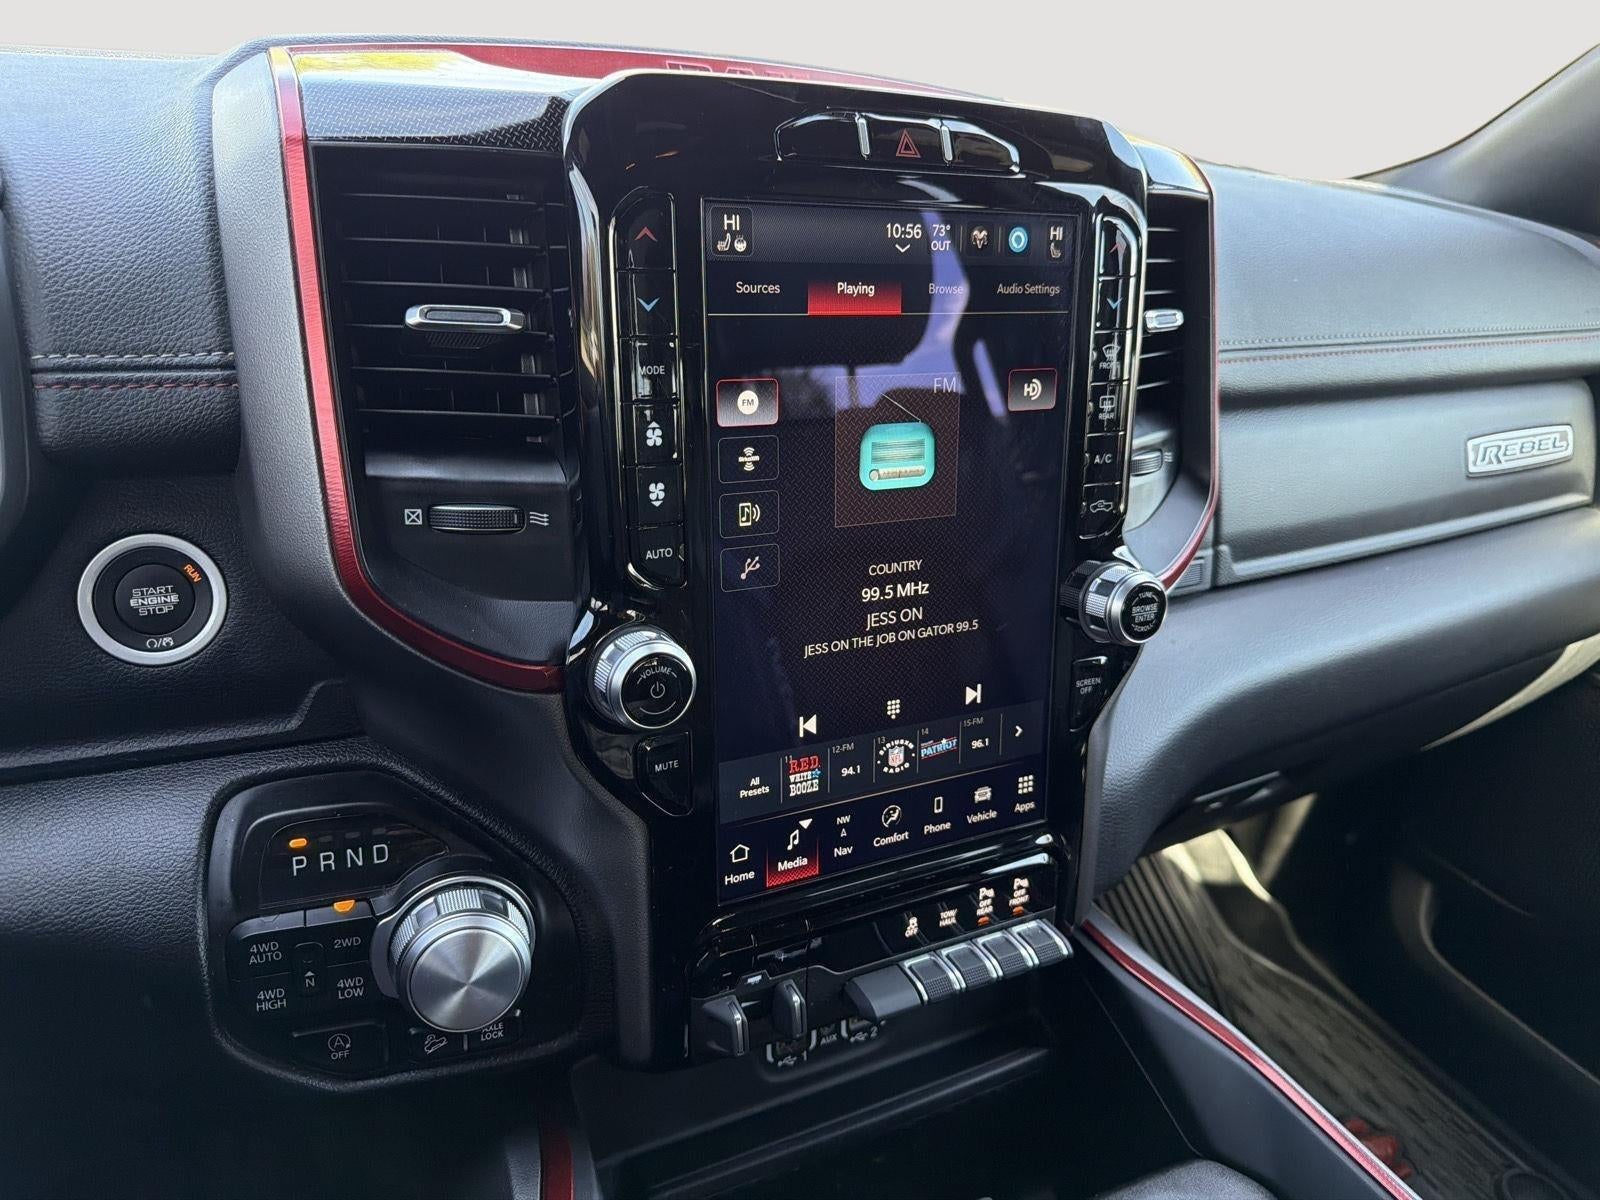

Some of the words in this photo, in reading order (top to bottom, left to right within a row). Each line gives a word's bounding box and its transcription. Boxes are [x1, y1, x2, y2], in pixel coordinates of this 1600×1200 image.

[723, 214, 740, 231] HI
[886, 223, 922, 239] 10:56
[932, 224, 951, 237] 73°
[1049, 226, 1064, 241] HI
[930, 240, 951, 251] OUT
[735, 281, 780, 295] Sources
[837, 281, 875, 297] Playing
[928, 283, 964, 295] Browse
[997, 283, 1024, 295] Audio
[1024, 283, 1061, 297] Settings
[638, 365, 666, 375] MODE
[933, 377, 957, 394] FM
[741, 398, 755, 407] FM
[1098, 412, 1115, 420] REAR
[1475, 432, 1568, 465] REBEL
[1094, 453, 1113, 464] A/C
[645, 547, 673, 560] AUTO
[183, 564, 202, 583] RUN
[868, 559, 923, 576] COUNTRY
[132, 585, 174, 597] START
[861, 585, 894, 603] 99.5
[896, 581, 930, 599] MHz
[1138, 591, 1153, 599] TUNE
[129, 594, 180, 607] ENGINE
[138, 605, 174, 616] STOP
[1131, 603, 1158, 614] BROWSE
[866, 610, 897, 631] JESS
[899, 607, 923, 624] ON
[1134, 613, 1155, 623] ENTER
[804, 643, 829, 659] JESS
[830, 639, 850, 652] ON
[852, 636, 874, 649] THE
[875, 632, 897, 648] JOB
[898, 629, 916, 642] ON
[917, 623, 955, 640] GATOR
[955, 619, 979, 634] 99.5
[639, 667, 673, 680] VOLUME
[1075, 677, 1101, 688] SCREEN
[1080, 686, 1093, 695] OFF
[963, 717, 984, 728] 15-FM
[921, 727, 929, 736] 14
[877, 736, 886, 745] 13
[971, 738, 990, 749] 96.1
[832, 743, 855, 754] 12-FM
[920, 738, 958, 758] PATRIOT
[654, 760, 680, 773] MUTE
[841, 765, 861, 777] 94.1
[882, 762, 910, 774] RADIO
[749, 776, 760, 786] All
[789, 771, 812, 783] WHITE
[739, 785, 770, 799] Presets
[789, 779, 819, 797] BOOZE
[1014, 802, 1036, 814] Apps
[836, 815, 851, 825] NW
[966, 809, 998, 824] Vehicle
[924, 821, 952, 836] Phone
[873, 830, 910, 848] Comfort
[834, 845, 853, 858] Nav
[291, 855, 308, 876] P
[320, 851, 336, 872] R
[346, 848, 364, 869] N
[372, 844, 390, 864] D
[777, 856, 808, 872] Media
[724, 871, 755, 886] Home
[1013, 889, 1027, 898] OFF
[979, 898, 992, 907] OFF
[1009, 895, 1030, 906] FRONT
[976, 906, 994, 916] REAR
[939, 917, 957, 927] HAUL
[905, 926, 919, 938] OFF
[249, 941, 279, 953] 4WD
[334, 936, 362, 949] 2WD
[249, 951, 282, 965] AUTO
[305, 977, 316, 988] N
[337, 976, 364, 989] 4WD
[257, 988, 285, 1000] 4WD
[338, 987, 364, 1000] LOW
[256, 999, 287, 1012] HIGH
[480, 1029, 504, 1041] LOCK
[870, 1026, 878, 1038] 2
[820, 1033, 838, 1045] AUX
[330, 1050, 350, 1060] OFF
